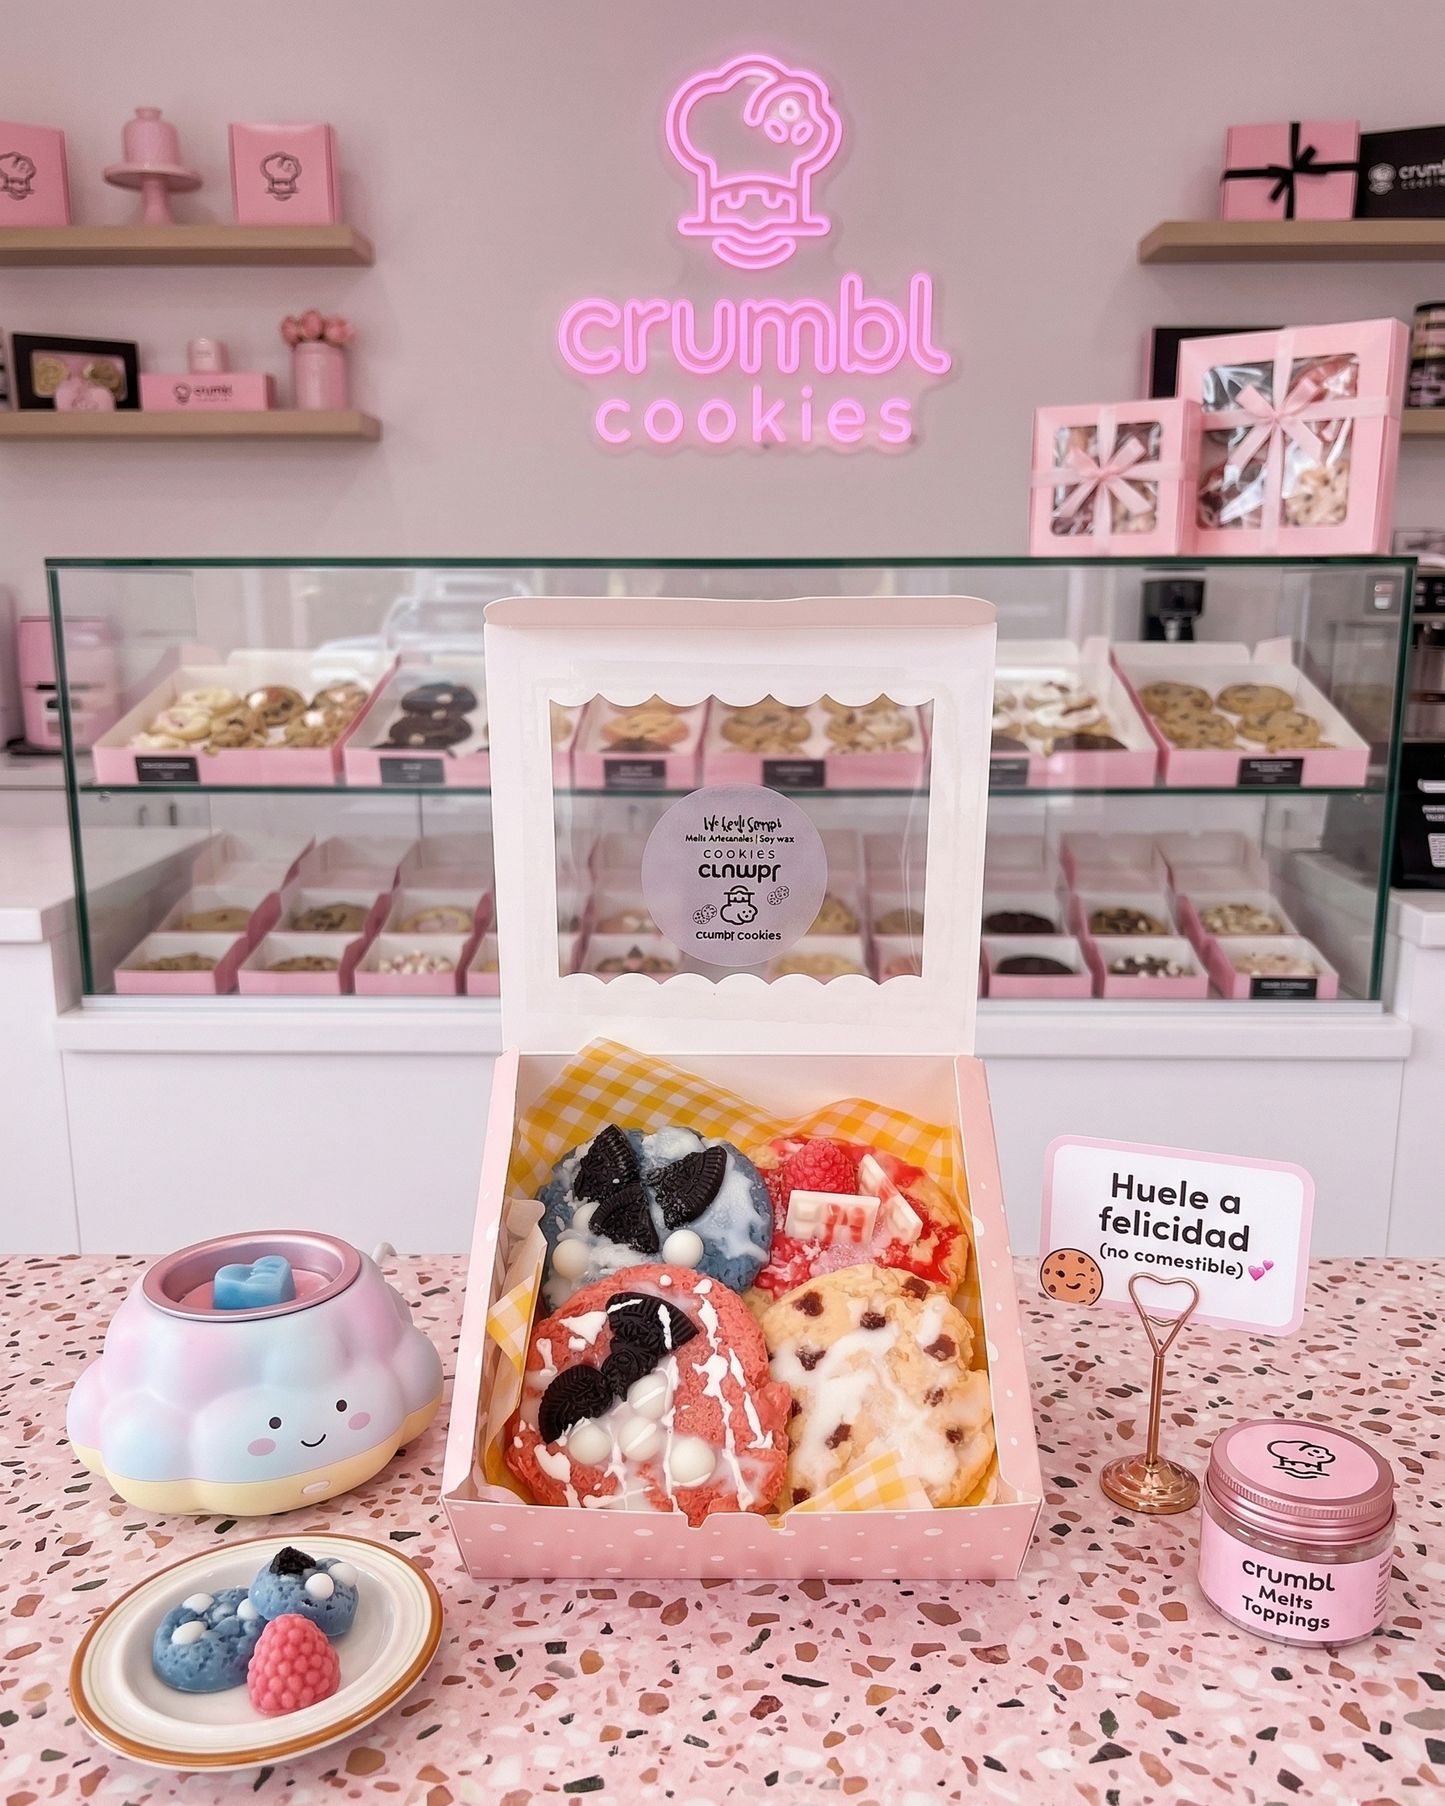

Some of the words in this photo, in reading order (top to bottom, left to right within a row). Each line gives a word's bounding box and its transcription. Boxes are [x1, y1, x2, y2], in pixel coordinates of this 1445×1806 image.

[558, 273, 951, 374] crumbl
[596, 385, 912, 443] cookies
[760, 835, 775, 844] Soy
[737, 930, 782, 940] cookies
[1111, 1172, 1209, 1210] Huele
[1220, 1195, 1241, 1214] a
[1099, 1206, 1250, 1252] felicidad
[1099, 1242, 1129, 1260] (no
[1134, 1251, 1244, 1280] comestible)
[1242, 1560, 1335, 1592] crumbl
[1242, 1595, 1330, 1632] Toppings
[1258, 1585, 1313, 1610] Melts
